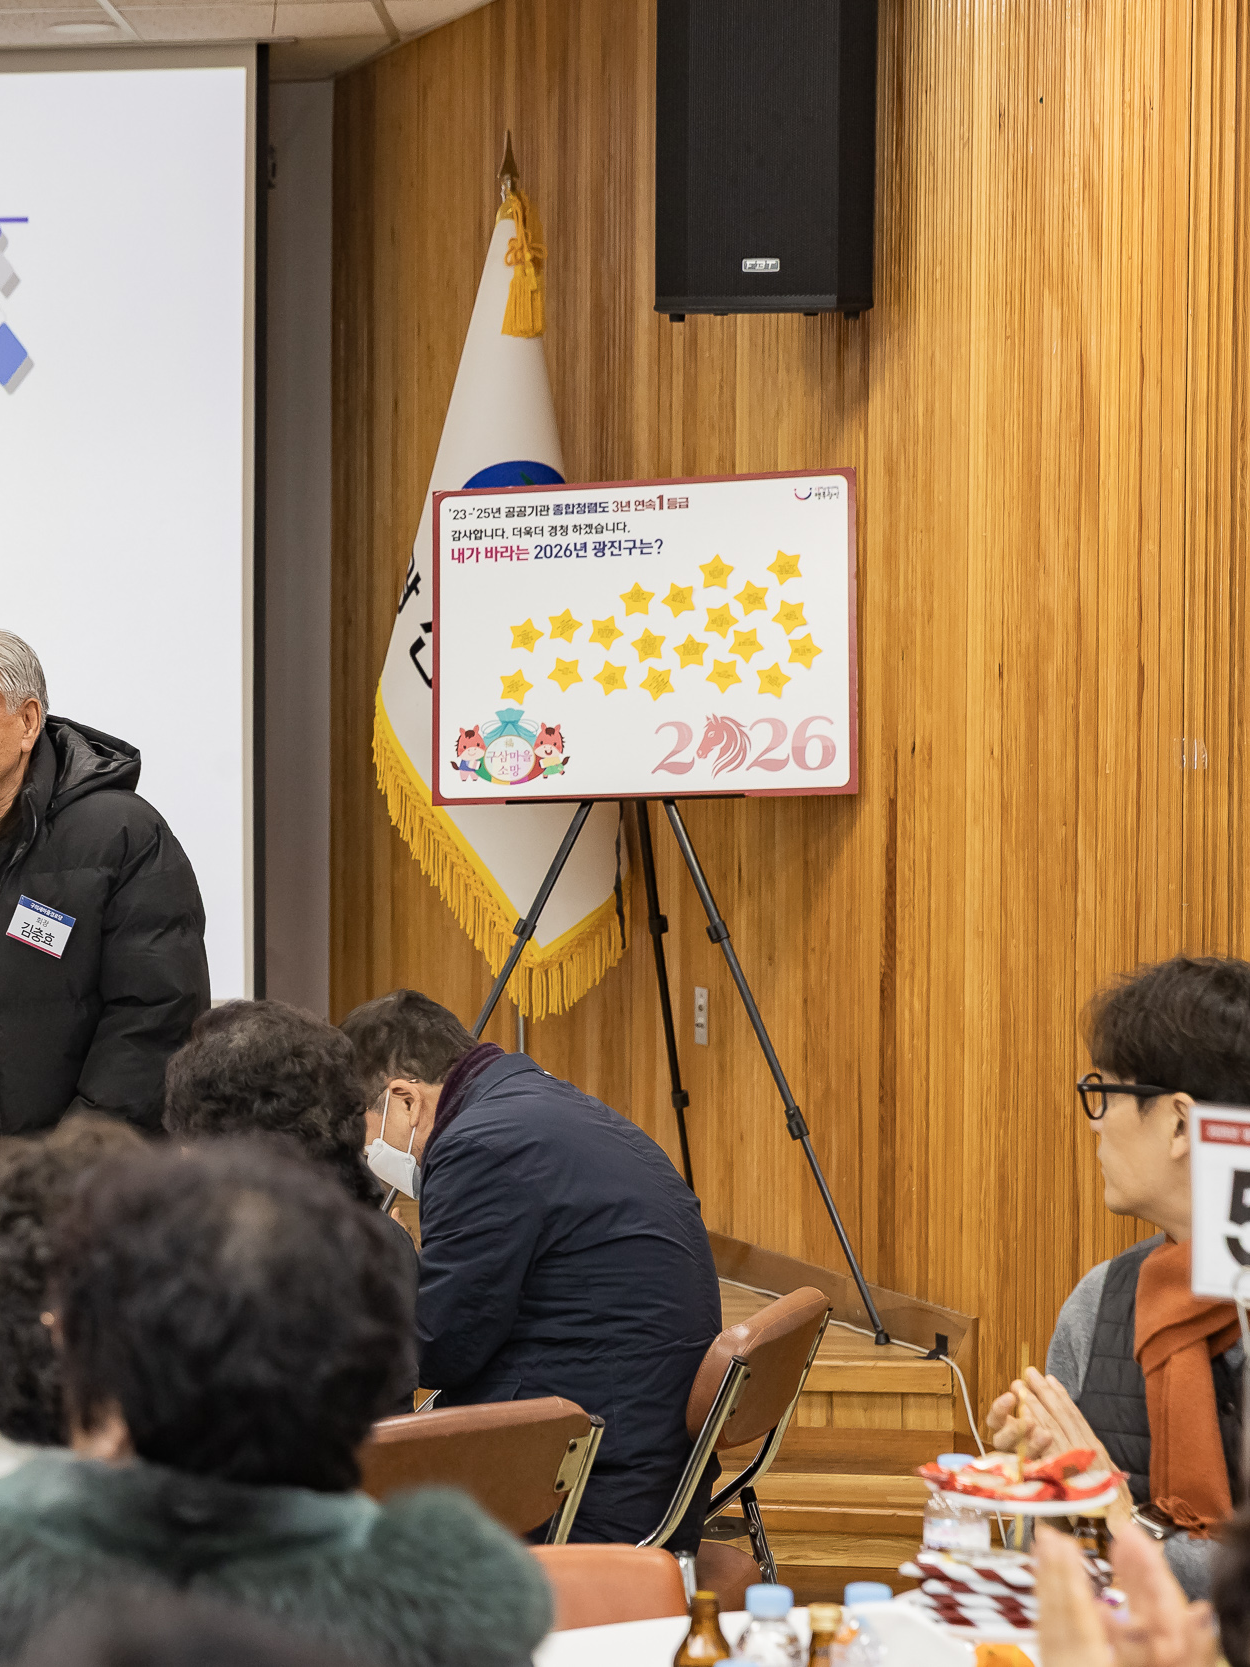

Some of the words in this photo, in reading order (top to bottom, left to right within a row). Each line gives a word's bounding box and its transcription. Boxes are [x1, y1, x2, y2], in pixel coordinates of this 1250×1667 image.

[504, 504, 551, 518] 공공기관
[552, 500, 610, 516] 종합청렴도
[612, 500, 631, 513] 3년
[451, 528, 509, 541] 감사합니다.
[512, 526, 544, 538] 더욱더
[548, 524, 569, 537] 경청
[571, 521, 631, 536] 하겠습니다.
[451, 547, 481, 564] 내가
[484, 545, 530, 562] 바라는
[533, 541, 588, 560] 2026년
[591, 538, 664, 558] 광진구는?
[486, 749, 533, 764] 구삼마을
[497, 764, 521, 777] 소망
